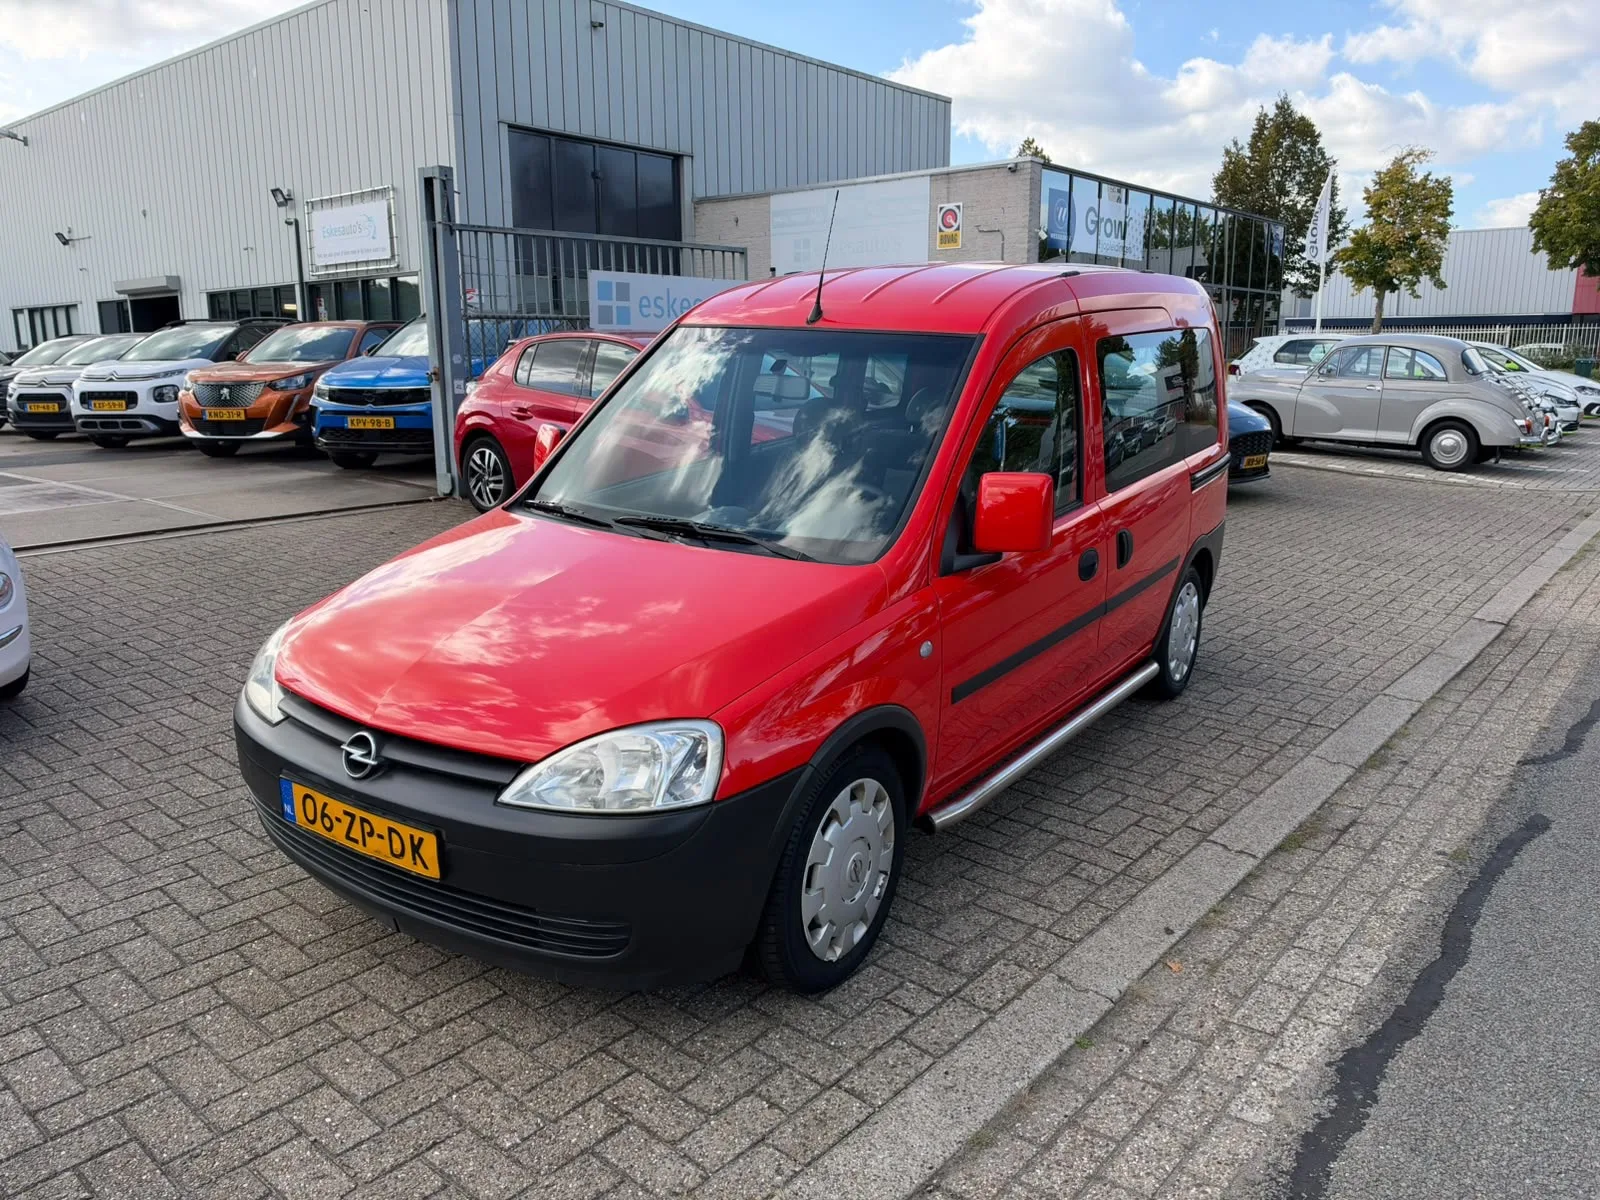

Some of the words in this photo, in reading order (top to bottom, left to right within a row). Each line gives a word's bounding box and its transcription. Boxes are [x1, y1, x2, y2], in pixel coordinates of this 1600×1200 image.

[940, 233, 958, 245] BOVAG
[207, 409, 242, 419] KND-31-R
[350, 417, 391, 428] KPV-98-B
[284, 803, 294, 815] NL
[301, 793, 429, 871] 06-ZP-DK
